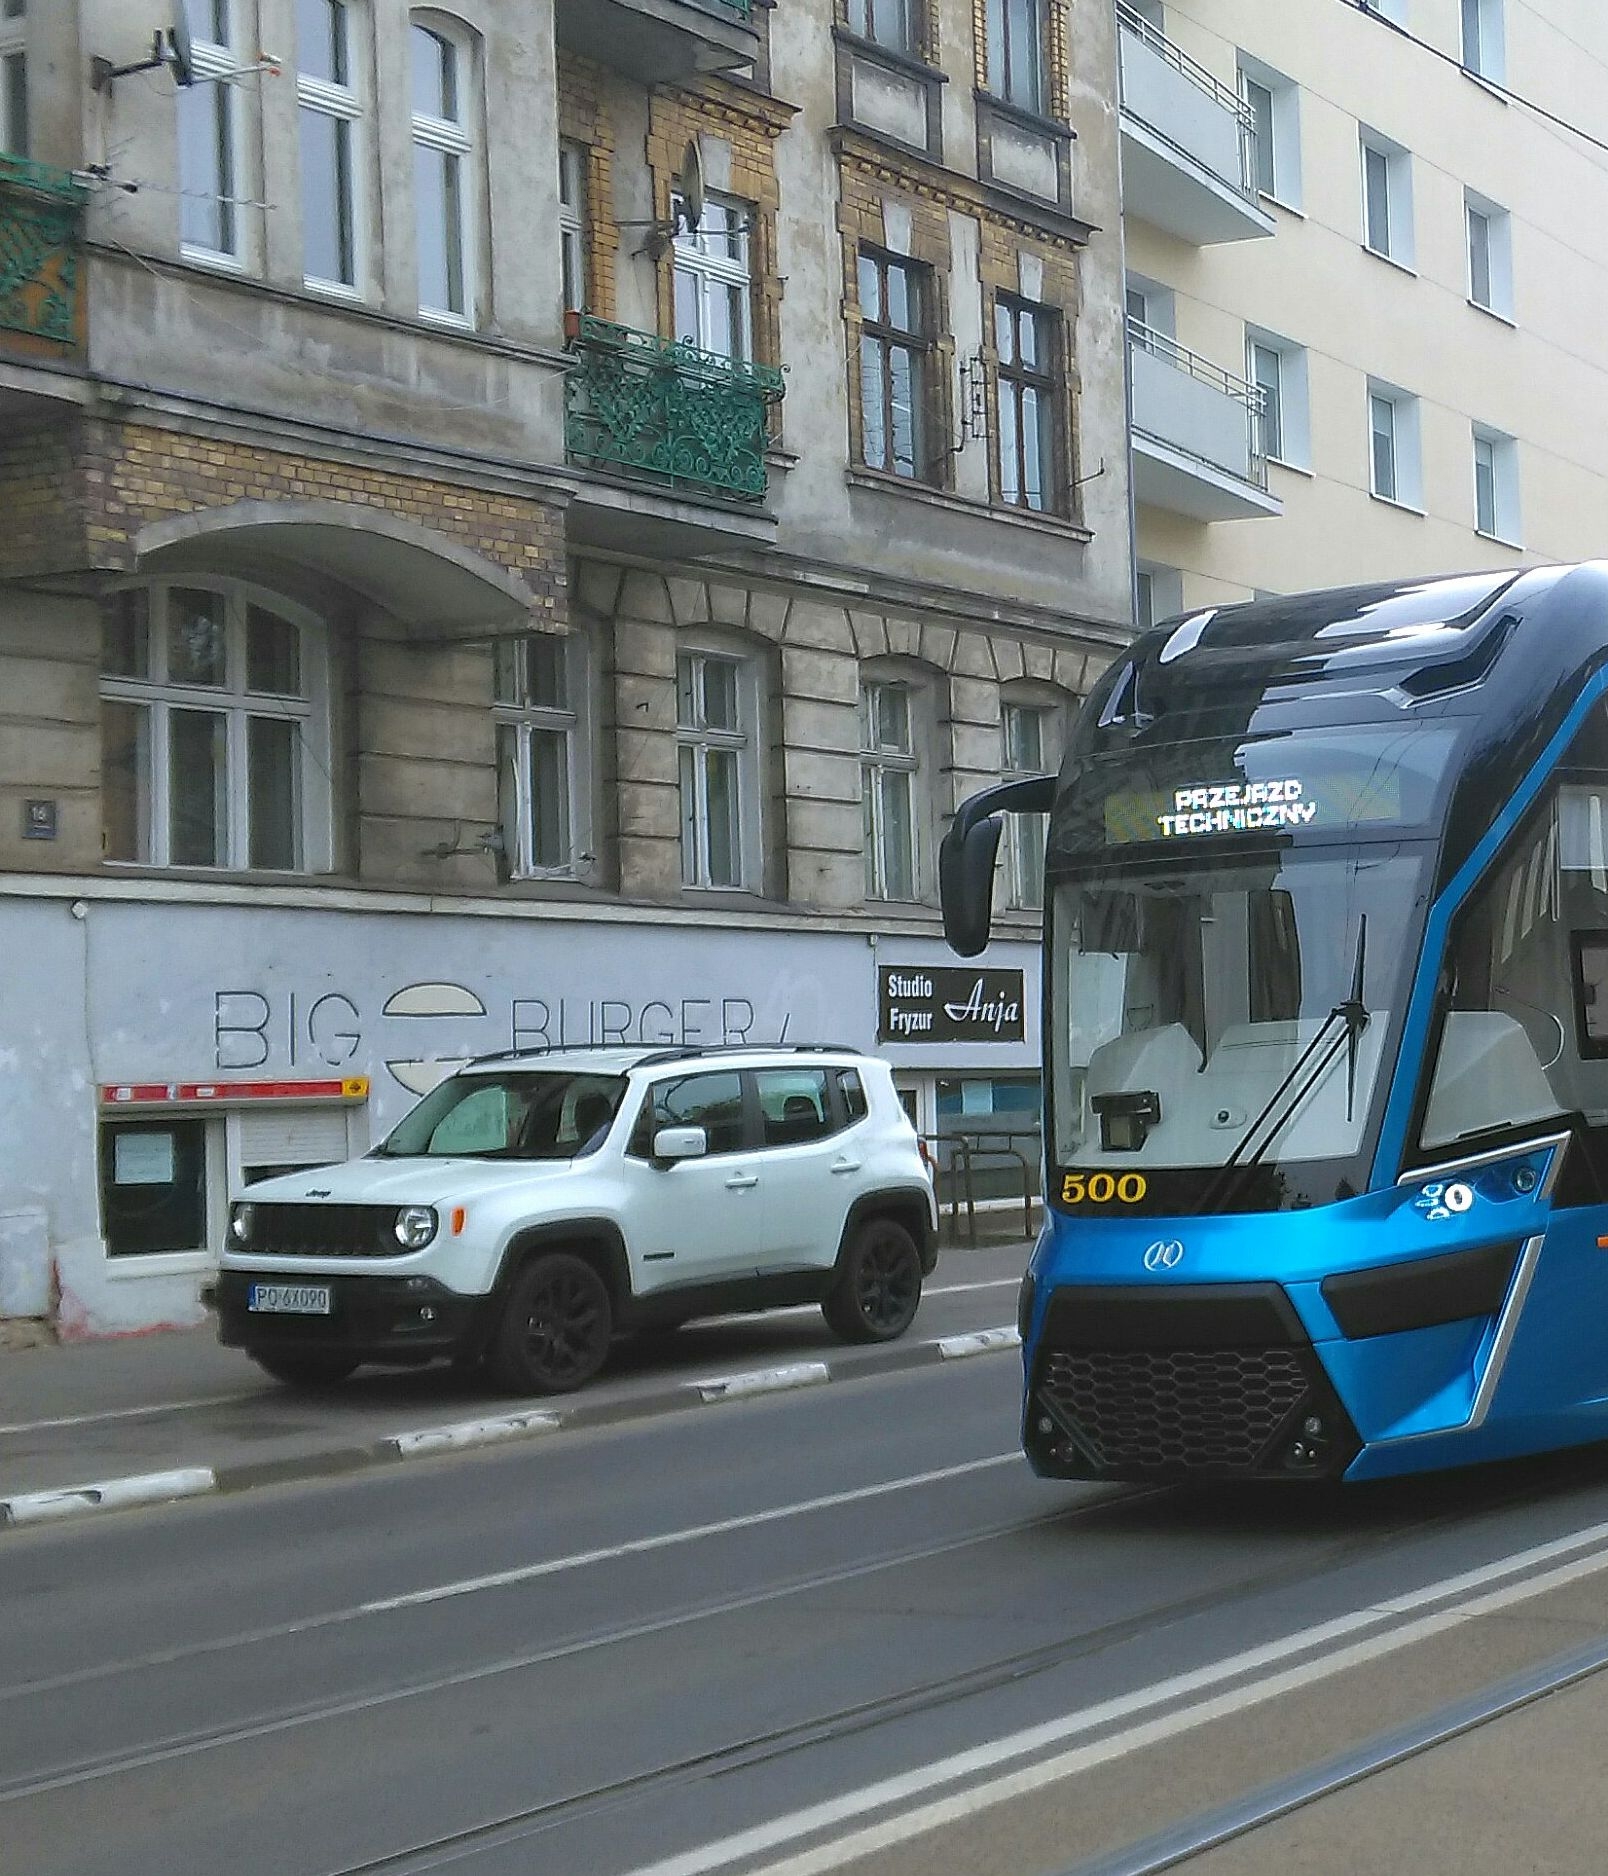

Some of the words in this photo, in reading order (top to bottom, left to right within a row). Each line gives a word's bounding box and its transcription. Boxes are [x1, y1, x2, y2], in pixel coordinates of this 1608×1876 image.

[1174, 780, 1302, 812] PRZEJAZD
[1157, 802, 1316, 836] TECHNICZNY
[888, 974, 933, 998] Studio
[944, 977, 1018, 1032] Anja
[215, 991, 361, 1069] BIG
[890, 1008, 933, 1035] Fryzur
[1062, 1173, 1147, 1203] 500
